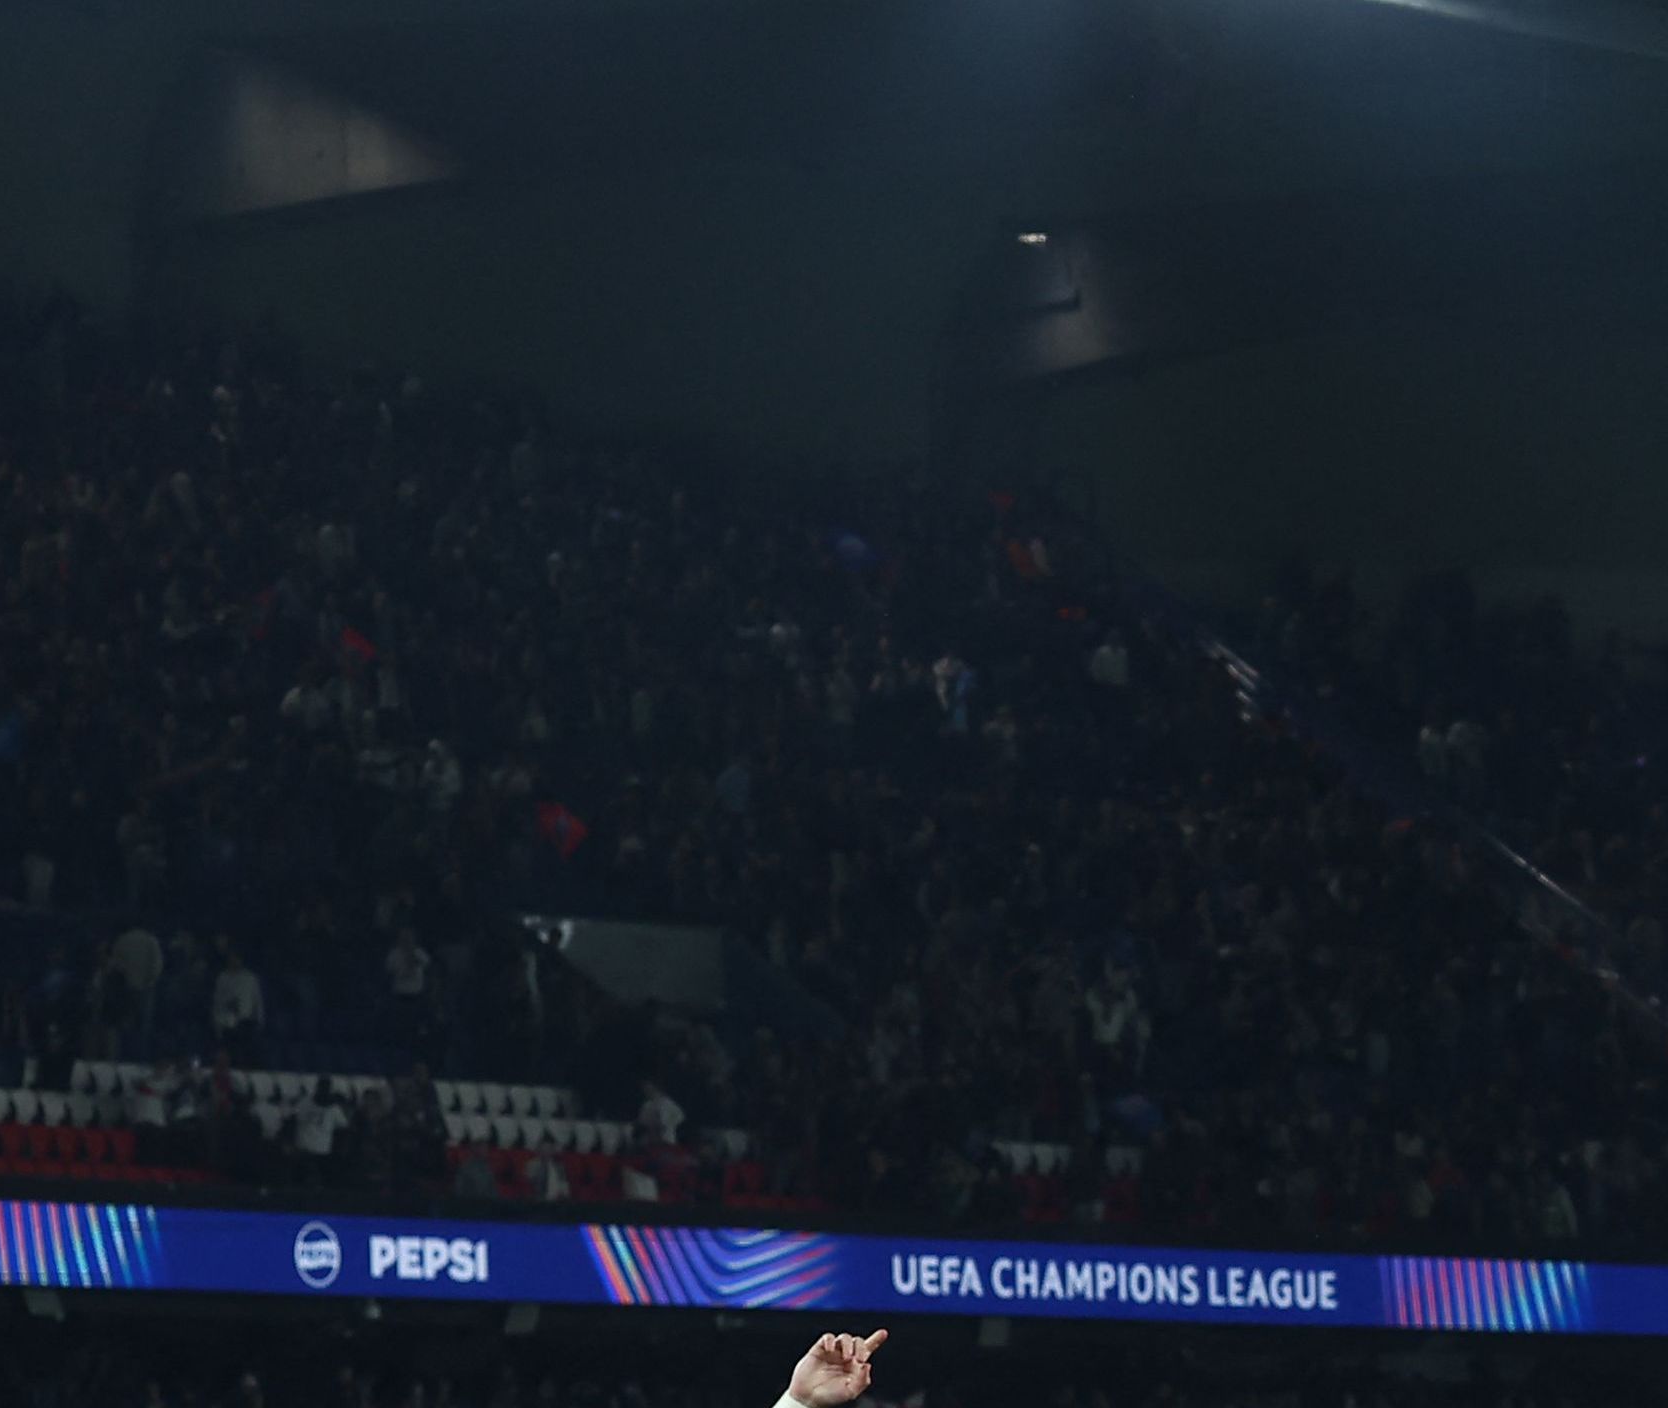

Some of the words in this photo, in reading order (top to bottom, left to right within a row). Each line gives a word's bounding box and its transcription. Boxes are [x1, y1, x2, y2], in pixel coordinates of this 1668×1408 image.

[369, 1235, 489, 1282] PEPSI
[892, 1254, 983, 1297] UEFA
[991, 1257, 1200, 1305] CHAMPIONS
[1207, 1267, 1338, 1309] LEAGUE
